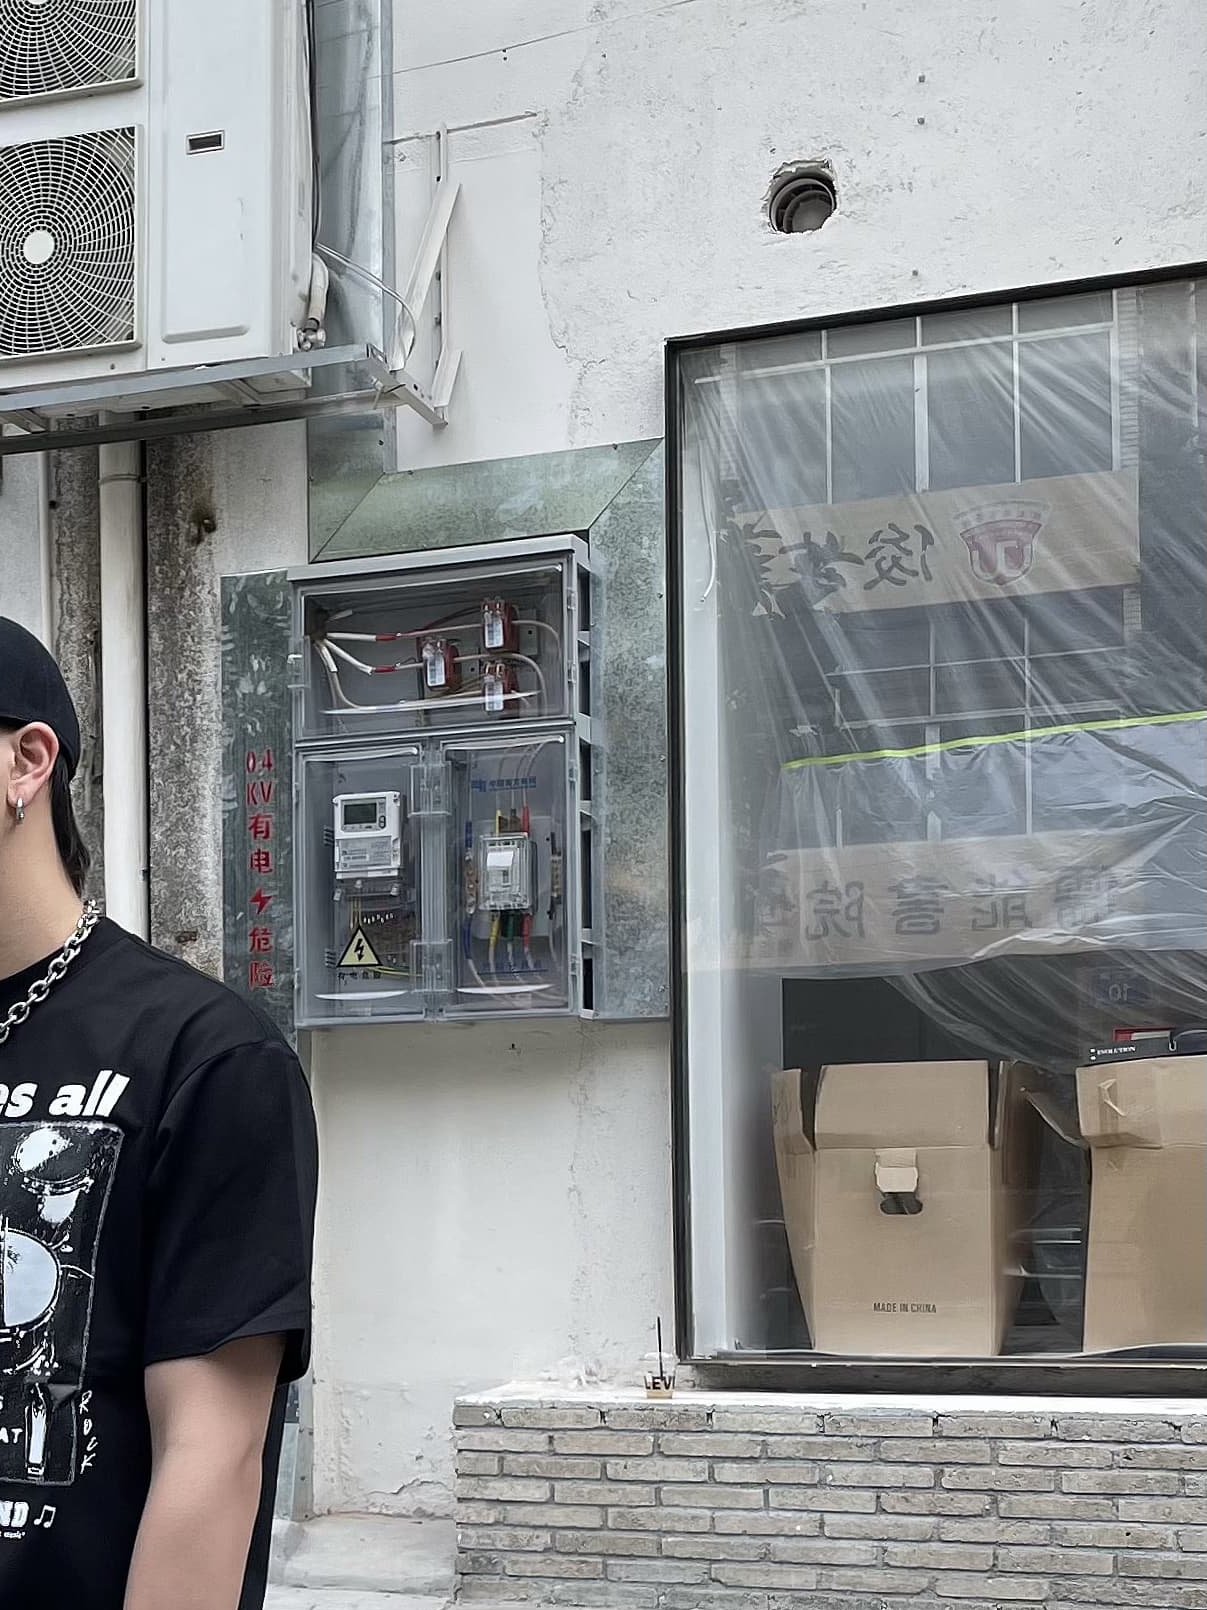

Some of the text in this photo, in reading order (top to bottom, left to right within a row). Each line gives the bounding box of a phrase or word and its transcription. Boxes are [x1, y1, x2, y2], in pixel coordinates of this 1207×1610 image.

[247, 780, 273, 805] KV
[48, 1069, 131, 1118] all
[873, 1302, 937, 1314] MADE IN CHINA
